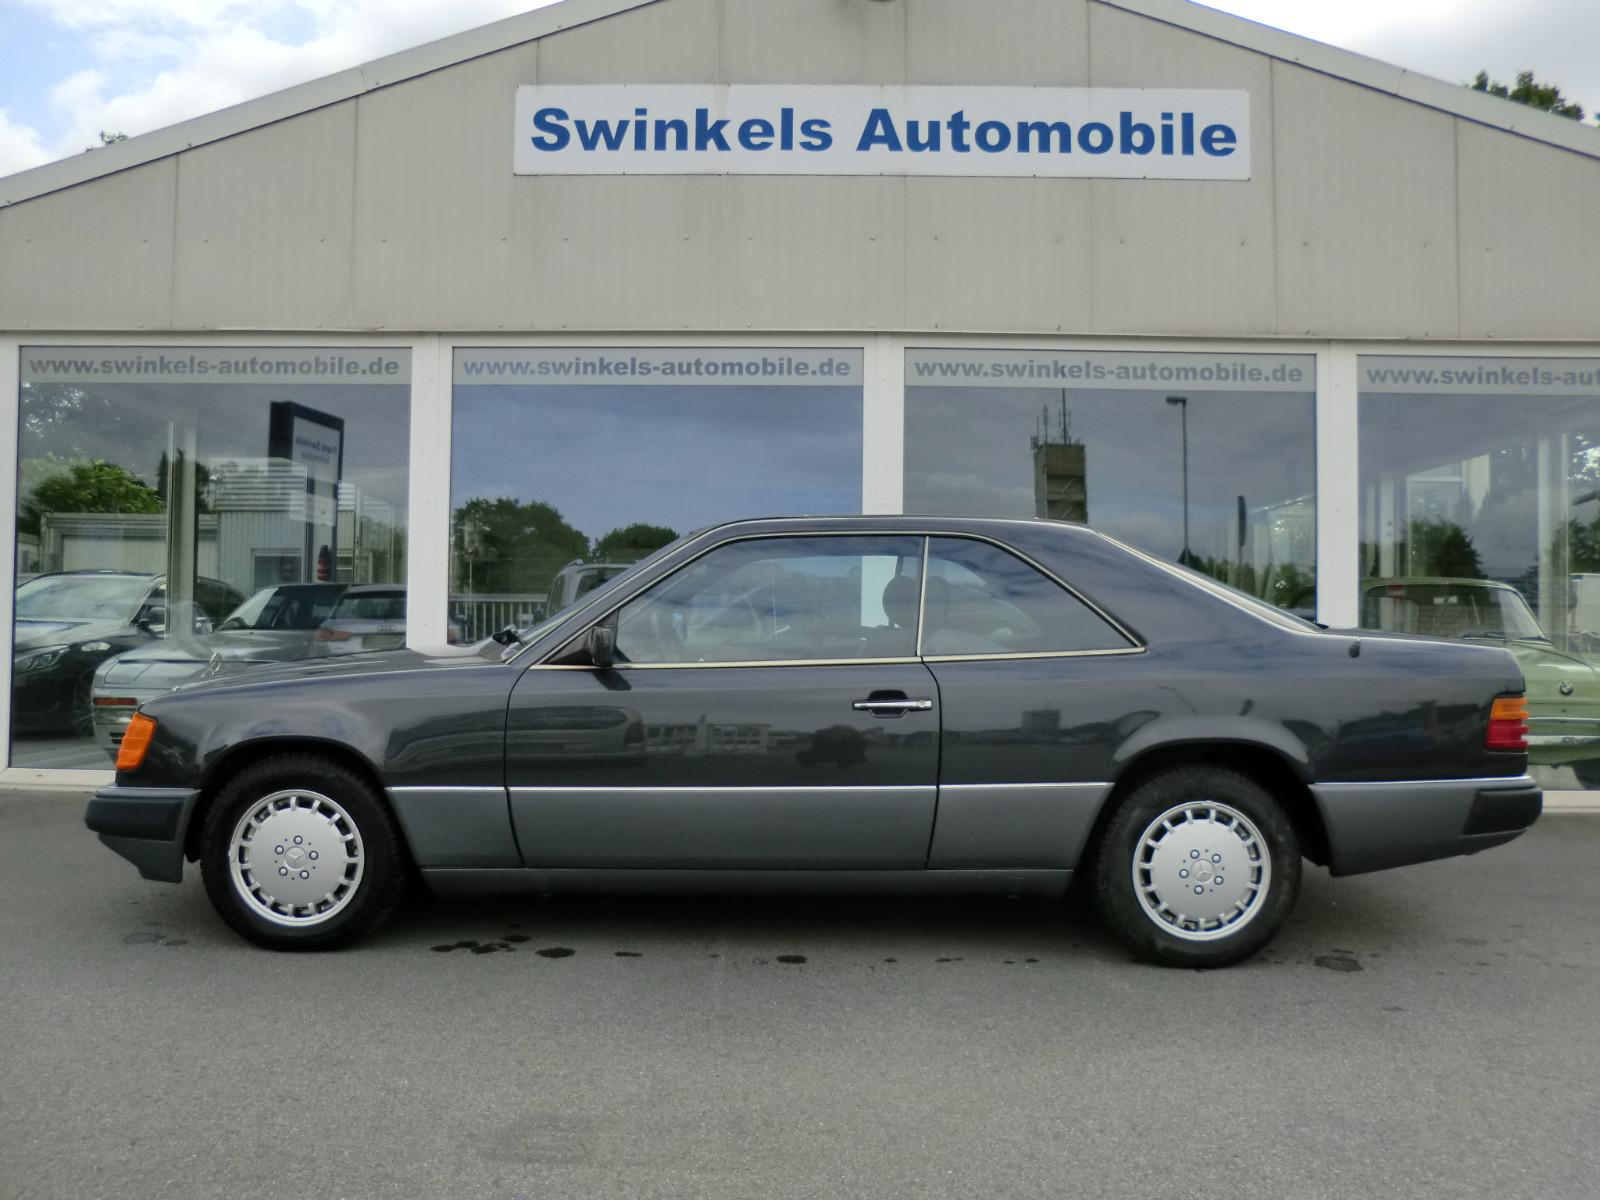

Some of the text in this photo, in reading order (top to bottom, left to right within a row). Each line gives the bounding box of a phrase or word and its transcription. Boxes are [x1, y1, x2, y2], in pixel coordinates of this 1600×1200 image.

[530, 107, 1237, 157] Swinkels Automobile
[28, 355, 400, 376] www.swinkels-automobile.de
[463, 356, 851, 377] www.swinkels-automobile.de
[914, 359, 1304, 383] www.swinkels-automobile.de
